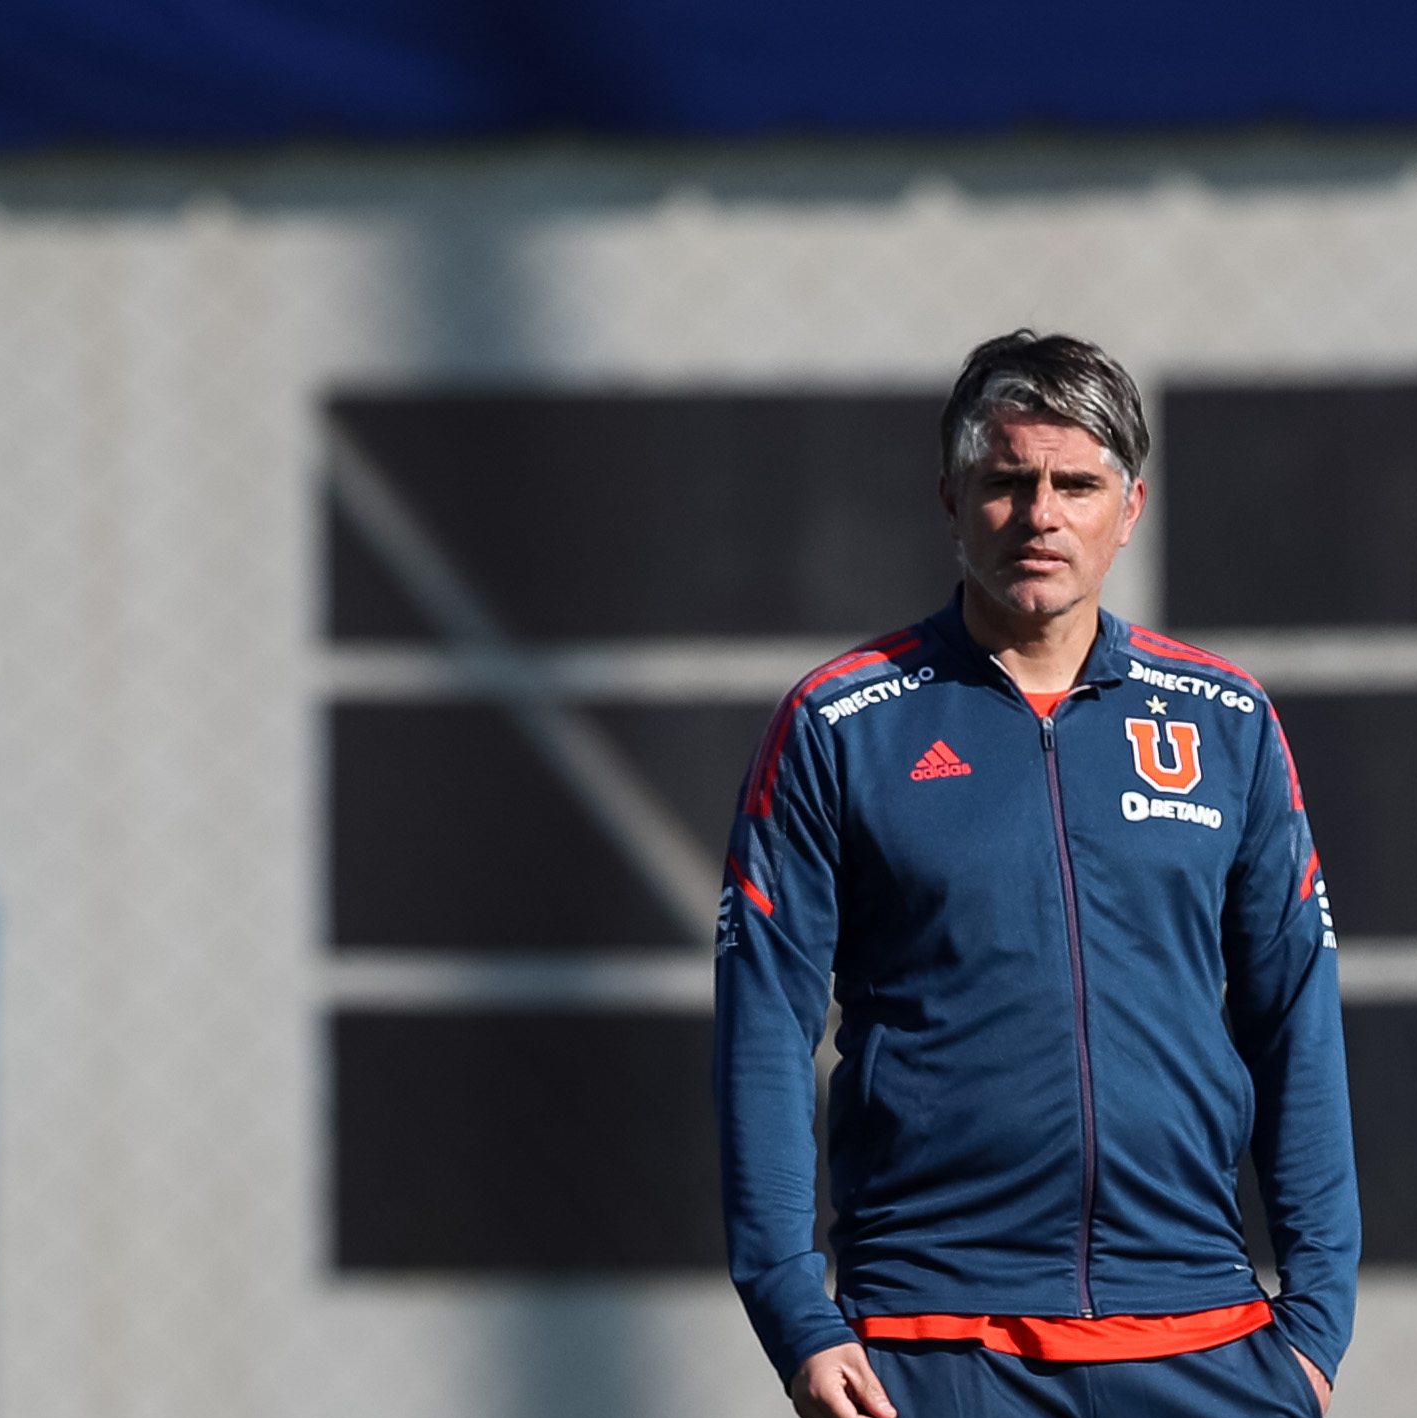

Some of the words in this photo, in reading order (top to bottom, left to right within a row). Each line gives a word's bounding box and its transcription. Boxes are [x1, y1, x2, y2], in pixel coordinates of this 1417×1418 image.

[818, 679, 902, 726] DIRECTV
[902, 666, 935, 691] GO
[1127, 659, 1221, 700] DIRECTV
[1220, 690, 1256, 714] GO
[909, 762, 973, 781] adidas
[1125, 717, 1203, 795] U
[1150, 798, 1223, 830] BETANO
